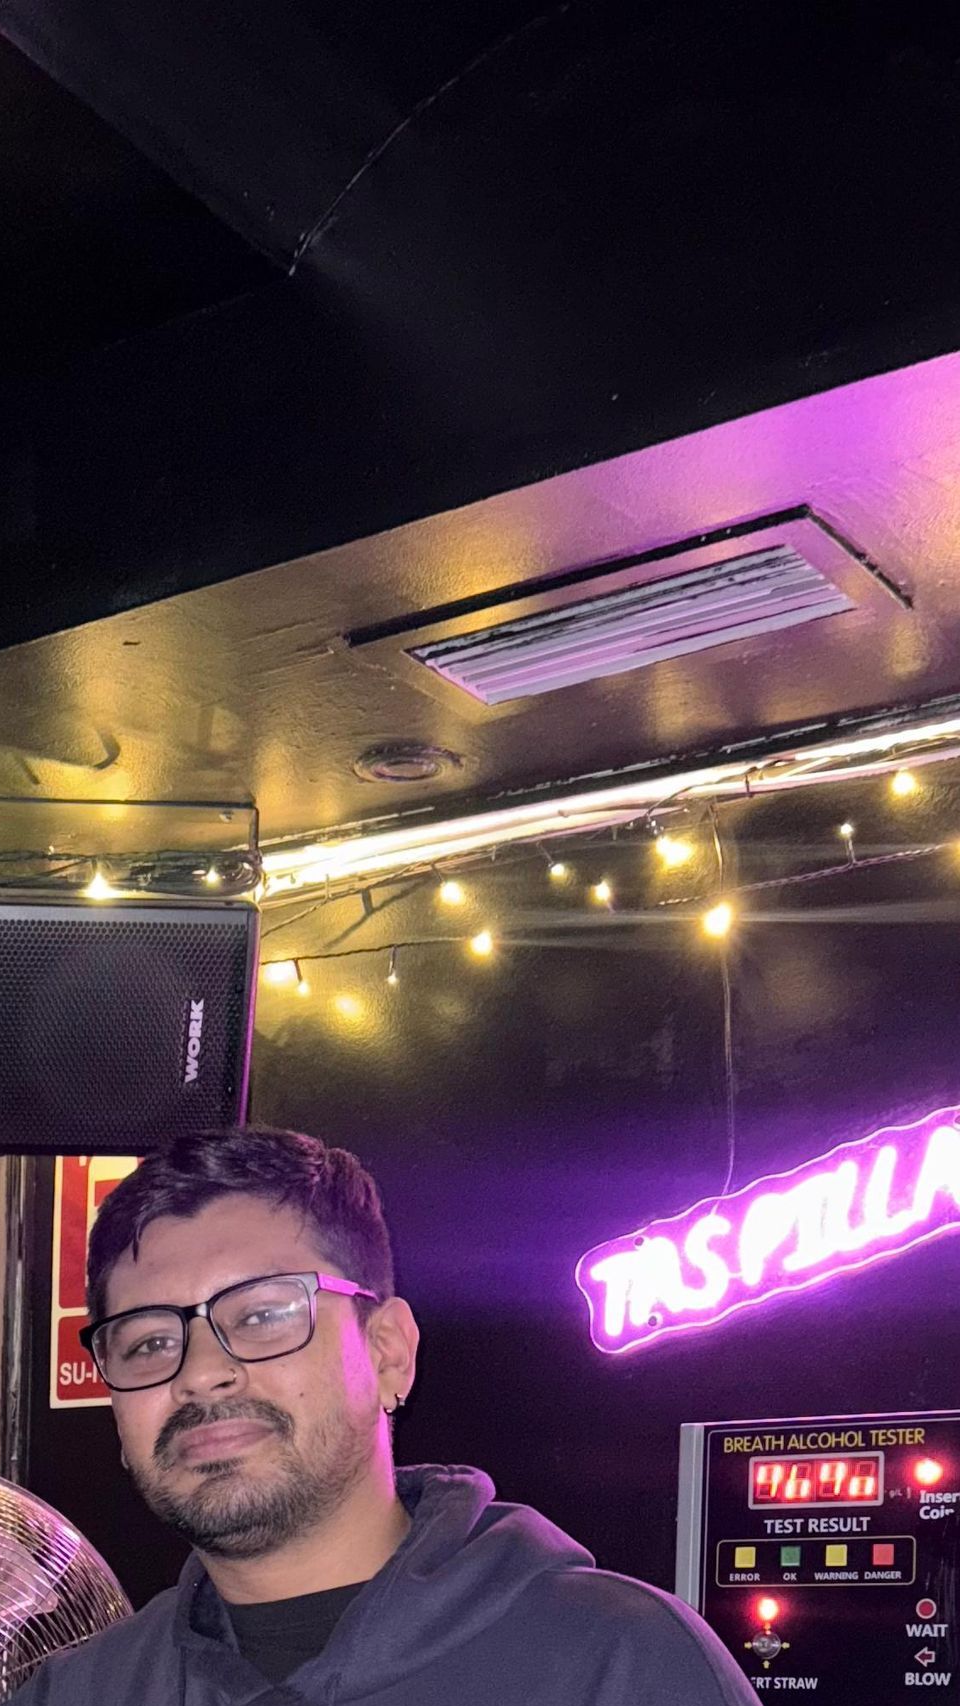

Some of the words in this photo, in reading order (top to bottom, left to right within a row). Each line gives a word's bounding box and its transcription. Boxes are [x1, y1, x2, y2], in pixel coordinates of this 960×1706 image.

[184, 998, 204, 1083] WORK
[723, 1434, 784, 1453] BREATH
[787, 1431, 866, 1450] ALCOHOL
[869, 1428, 926, 1446] TESTER
[764, 1518, 805, 1534] TEST
[807, 1516, 871, 1533] RESULT
[729, 1573, 761, 1582] ERROR
[783, 1572, 797, 1581] OK
[814, 1571, 859, 1580] WARNING
[864, 1571, 902, 1580] DANGER
[905, 1624, 949, 1638] WAIT
[773, 1676, 818, 1690] STRAW
[904, 1672, 952, 1686] BLOW
